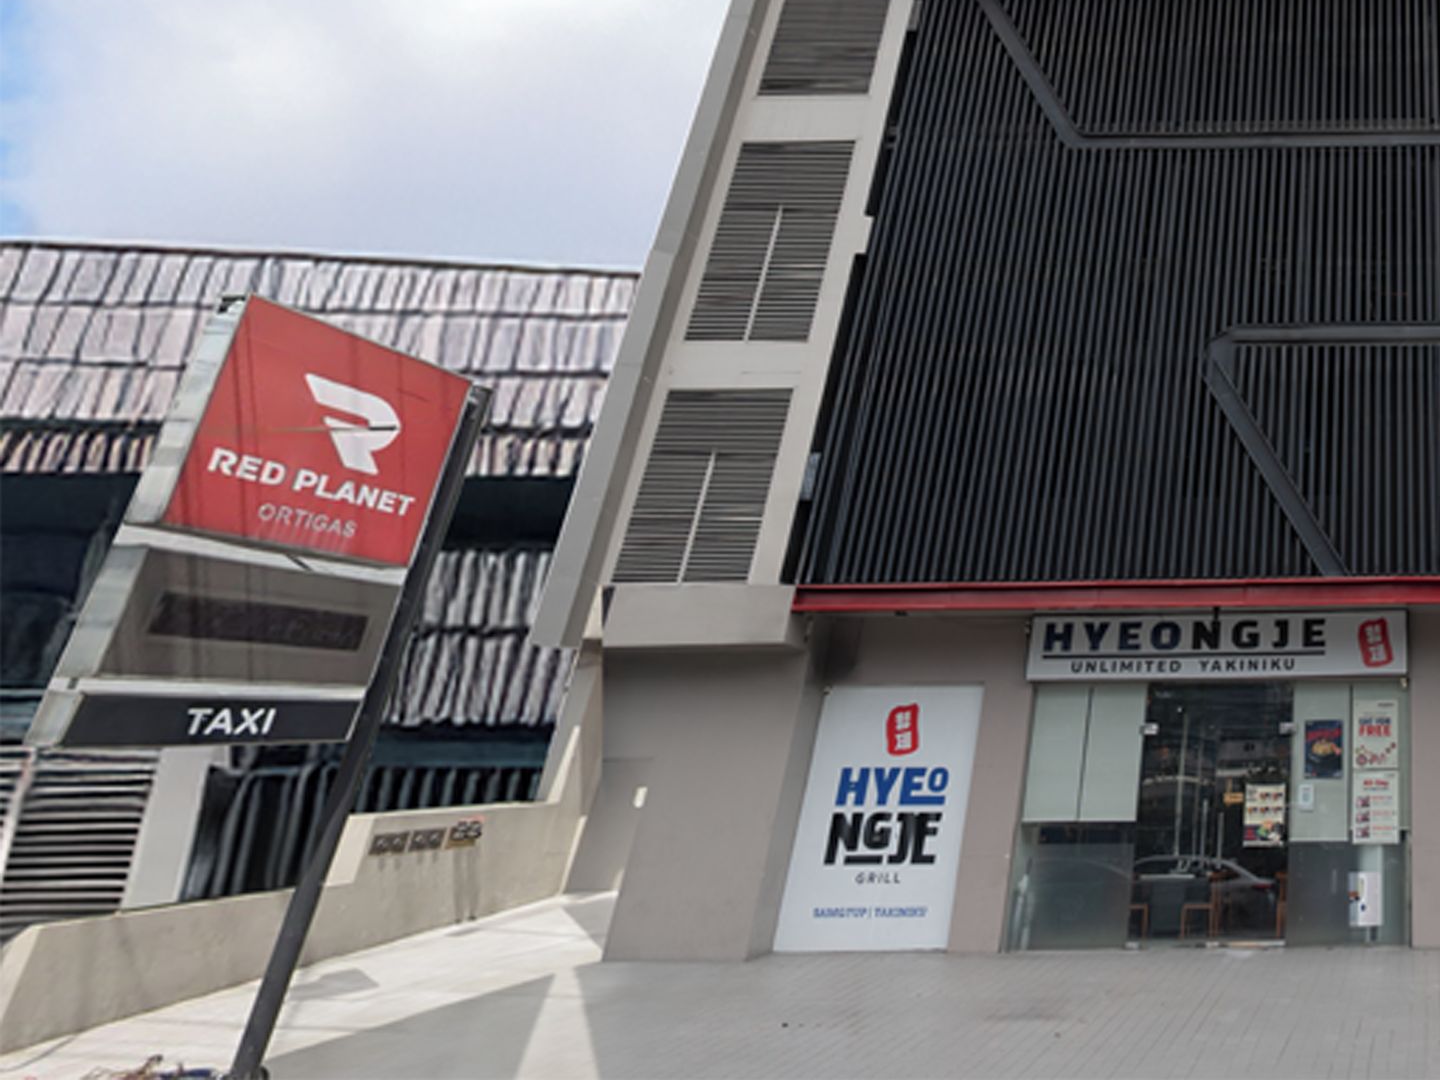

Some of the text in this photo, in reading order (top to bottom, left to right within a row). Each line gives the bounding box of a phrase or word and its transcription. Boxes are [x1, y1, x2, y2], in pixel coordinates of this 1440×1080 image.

[207, 447, 415, 517] RED PLANET
[257, 502, 358, 539] ORTIGAS
[1042, 618, 1327, 652] HYEONGJE
[1071, 658, 1296, 674] UNLIMITED YAKINIKU
[186, 707, 277, 736] TAXI
[823, 812, 944, 866] NGJE
[855, 872, 901, 885] GRILL
